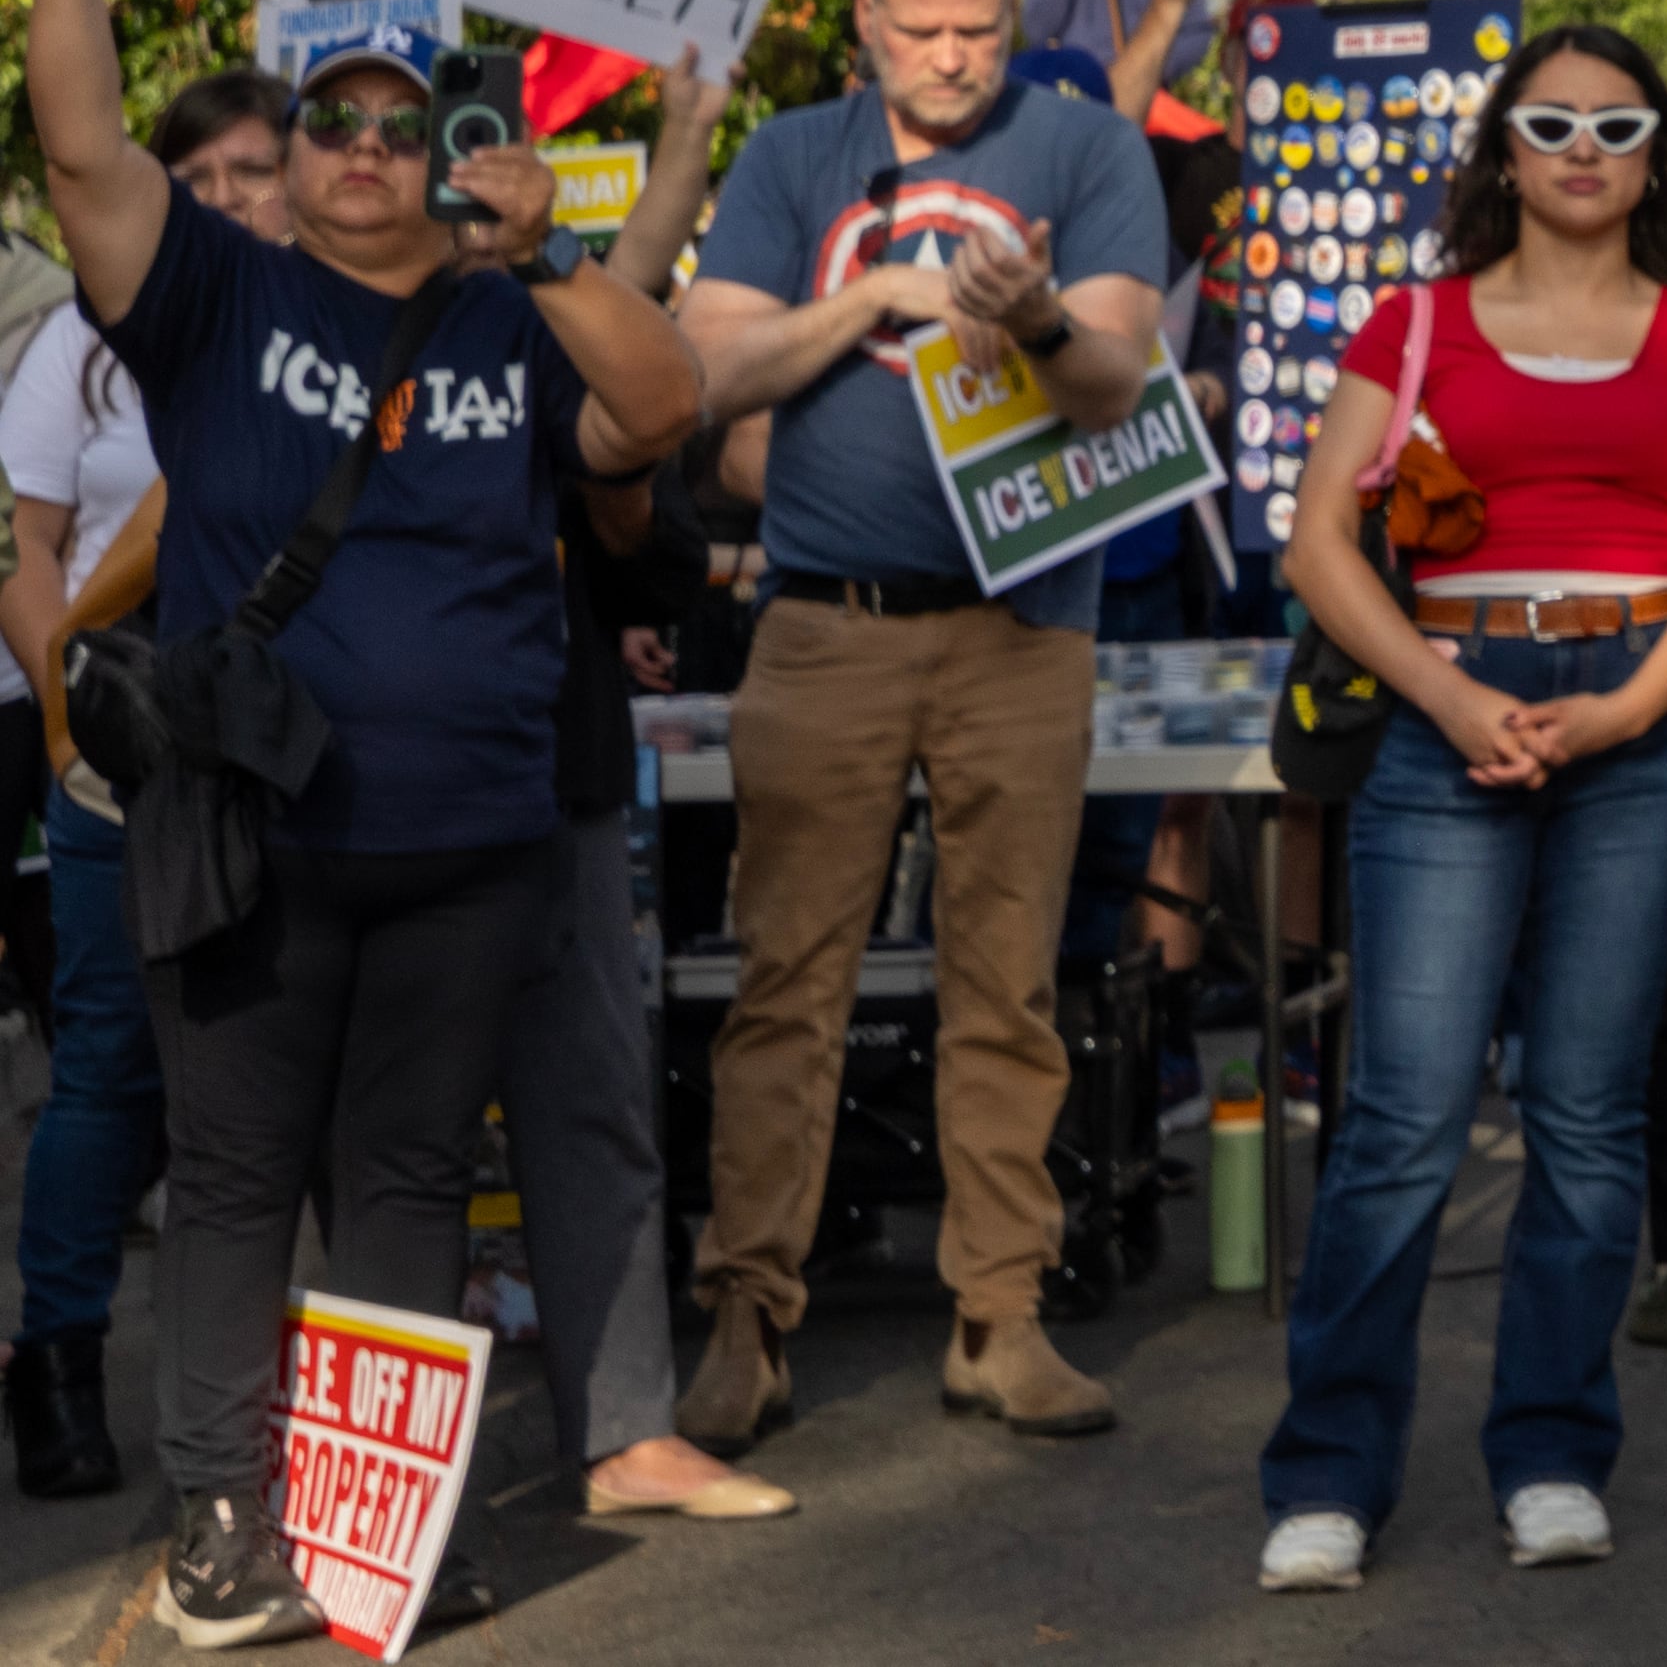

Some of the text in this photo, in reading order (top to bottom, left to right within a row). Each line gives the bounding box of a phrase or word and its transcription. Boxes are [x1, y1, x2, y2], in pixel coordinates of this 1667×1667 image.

[1061, 399, 1189, 501] DENA!
[972, 462, 1053, 541] ICE
[350, 1345, 409, 1439] OFF
[405, 1362, 466, 1457] MY
